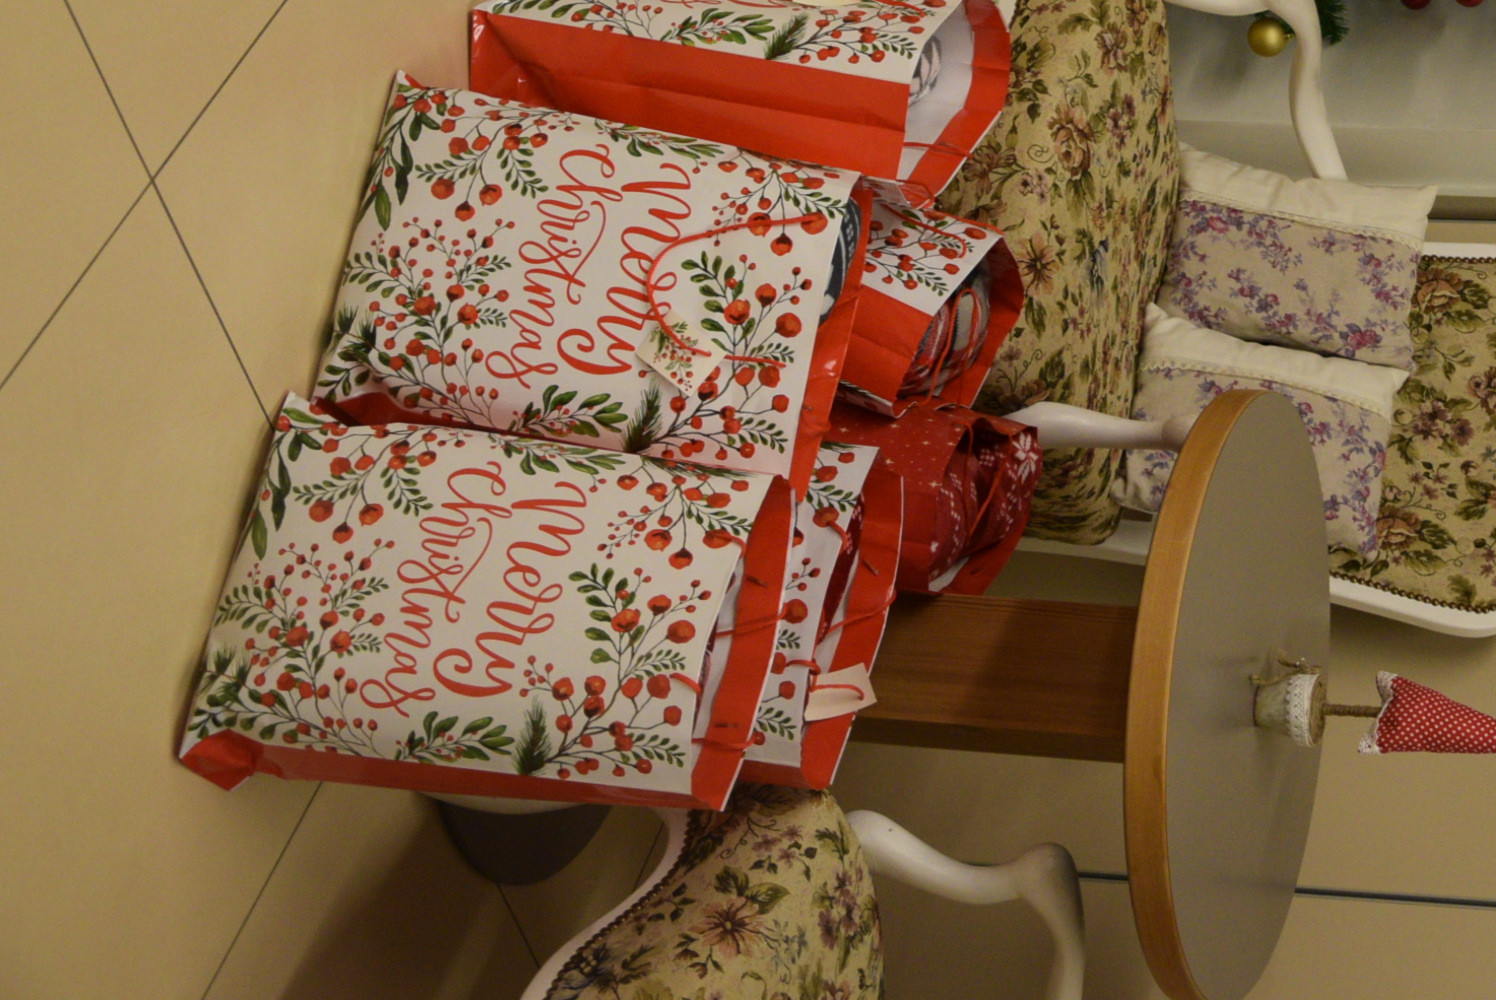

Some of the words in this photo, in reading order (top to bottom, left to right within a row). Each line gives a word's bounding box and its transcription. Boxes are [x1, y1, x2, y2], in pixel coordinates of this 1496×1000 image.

[486, 143, 623, 389] Christmas
[557, 163, 692, 375] Merry
[359, 461, 513, 718] Christmas
[433, 481, 587, 696] Merry
